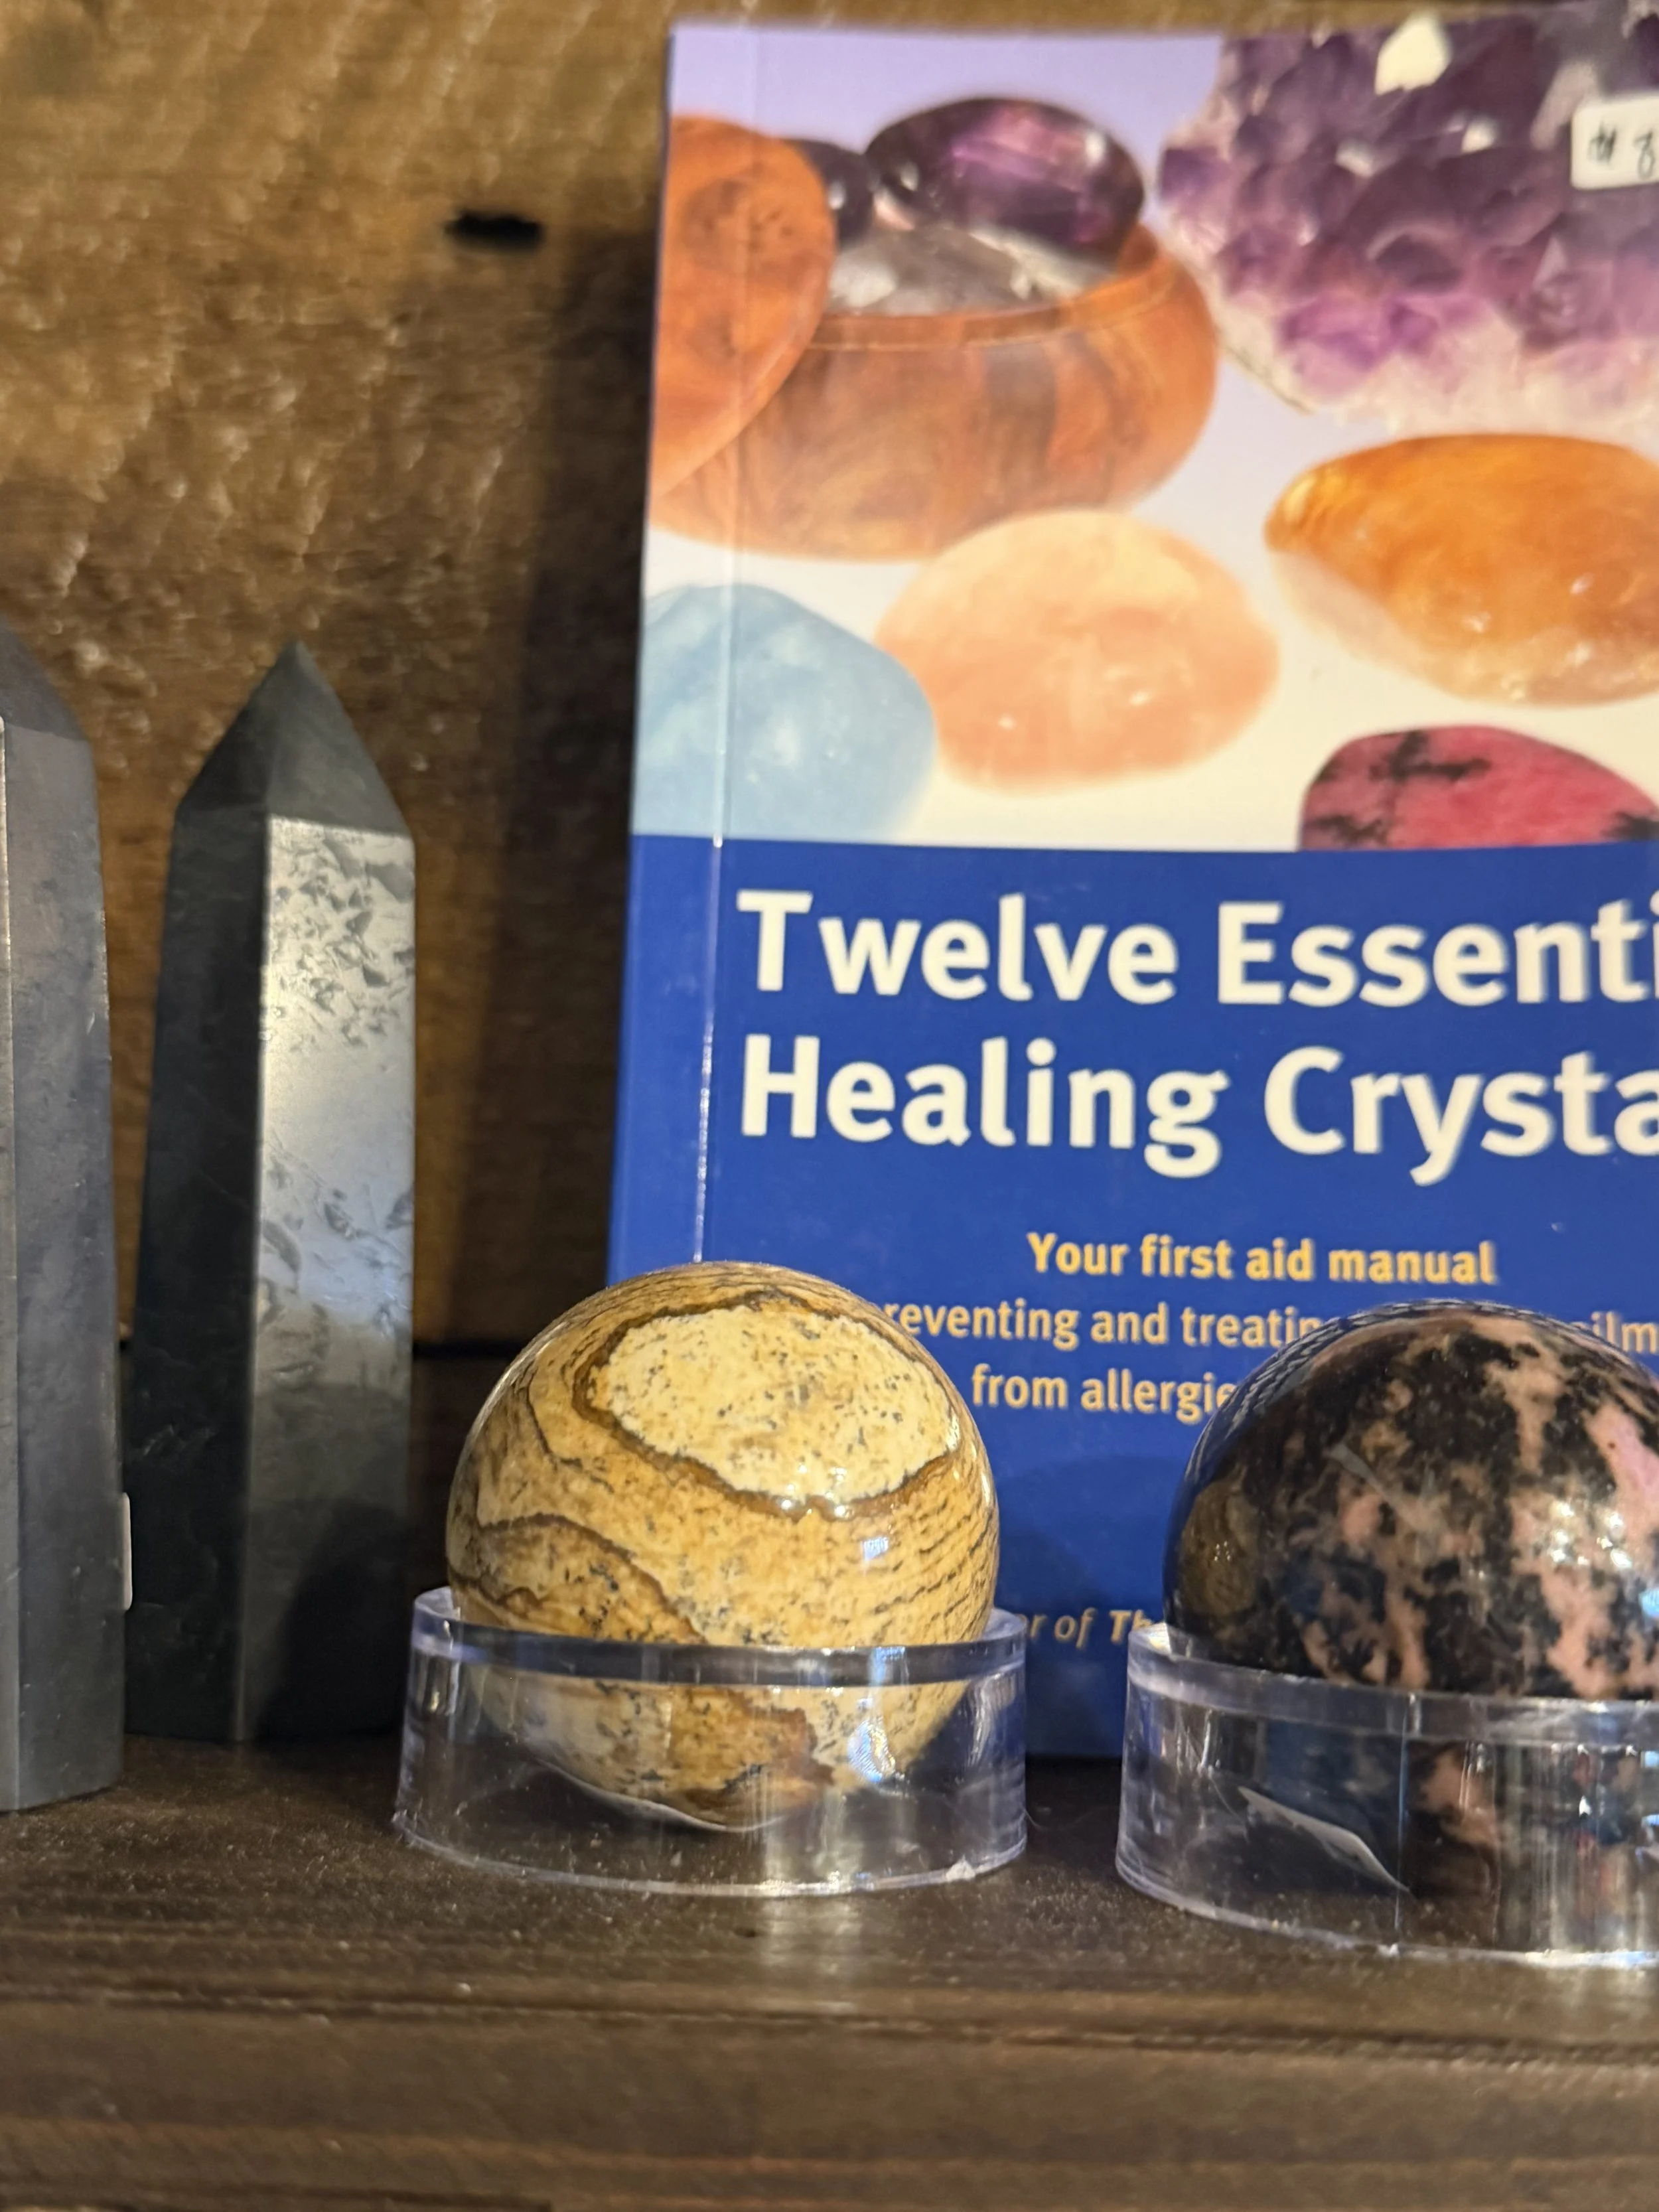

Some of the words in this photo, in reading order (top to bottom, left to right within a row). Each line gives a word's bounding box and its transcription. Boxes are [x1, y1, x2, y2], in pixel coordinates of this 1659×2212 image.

[736, 889, 1178, 1004] Twelve
[741, 1033, 1230, 1178] Healing
[1027, 1232, 1129, 1276] Your
[1139, 1233, 1234, 1280] first
[1246, 1237, 1315, 1282] aid
[1329, 1240, 1497, 1285] manual
[1090, 1301, 1169, 1345] and
[972, 1363, 1068, 1408] from
[1054, 1607, 1098, 1649] of
